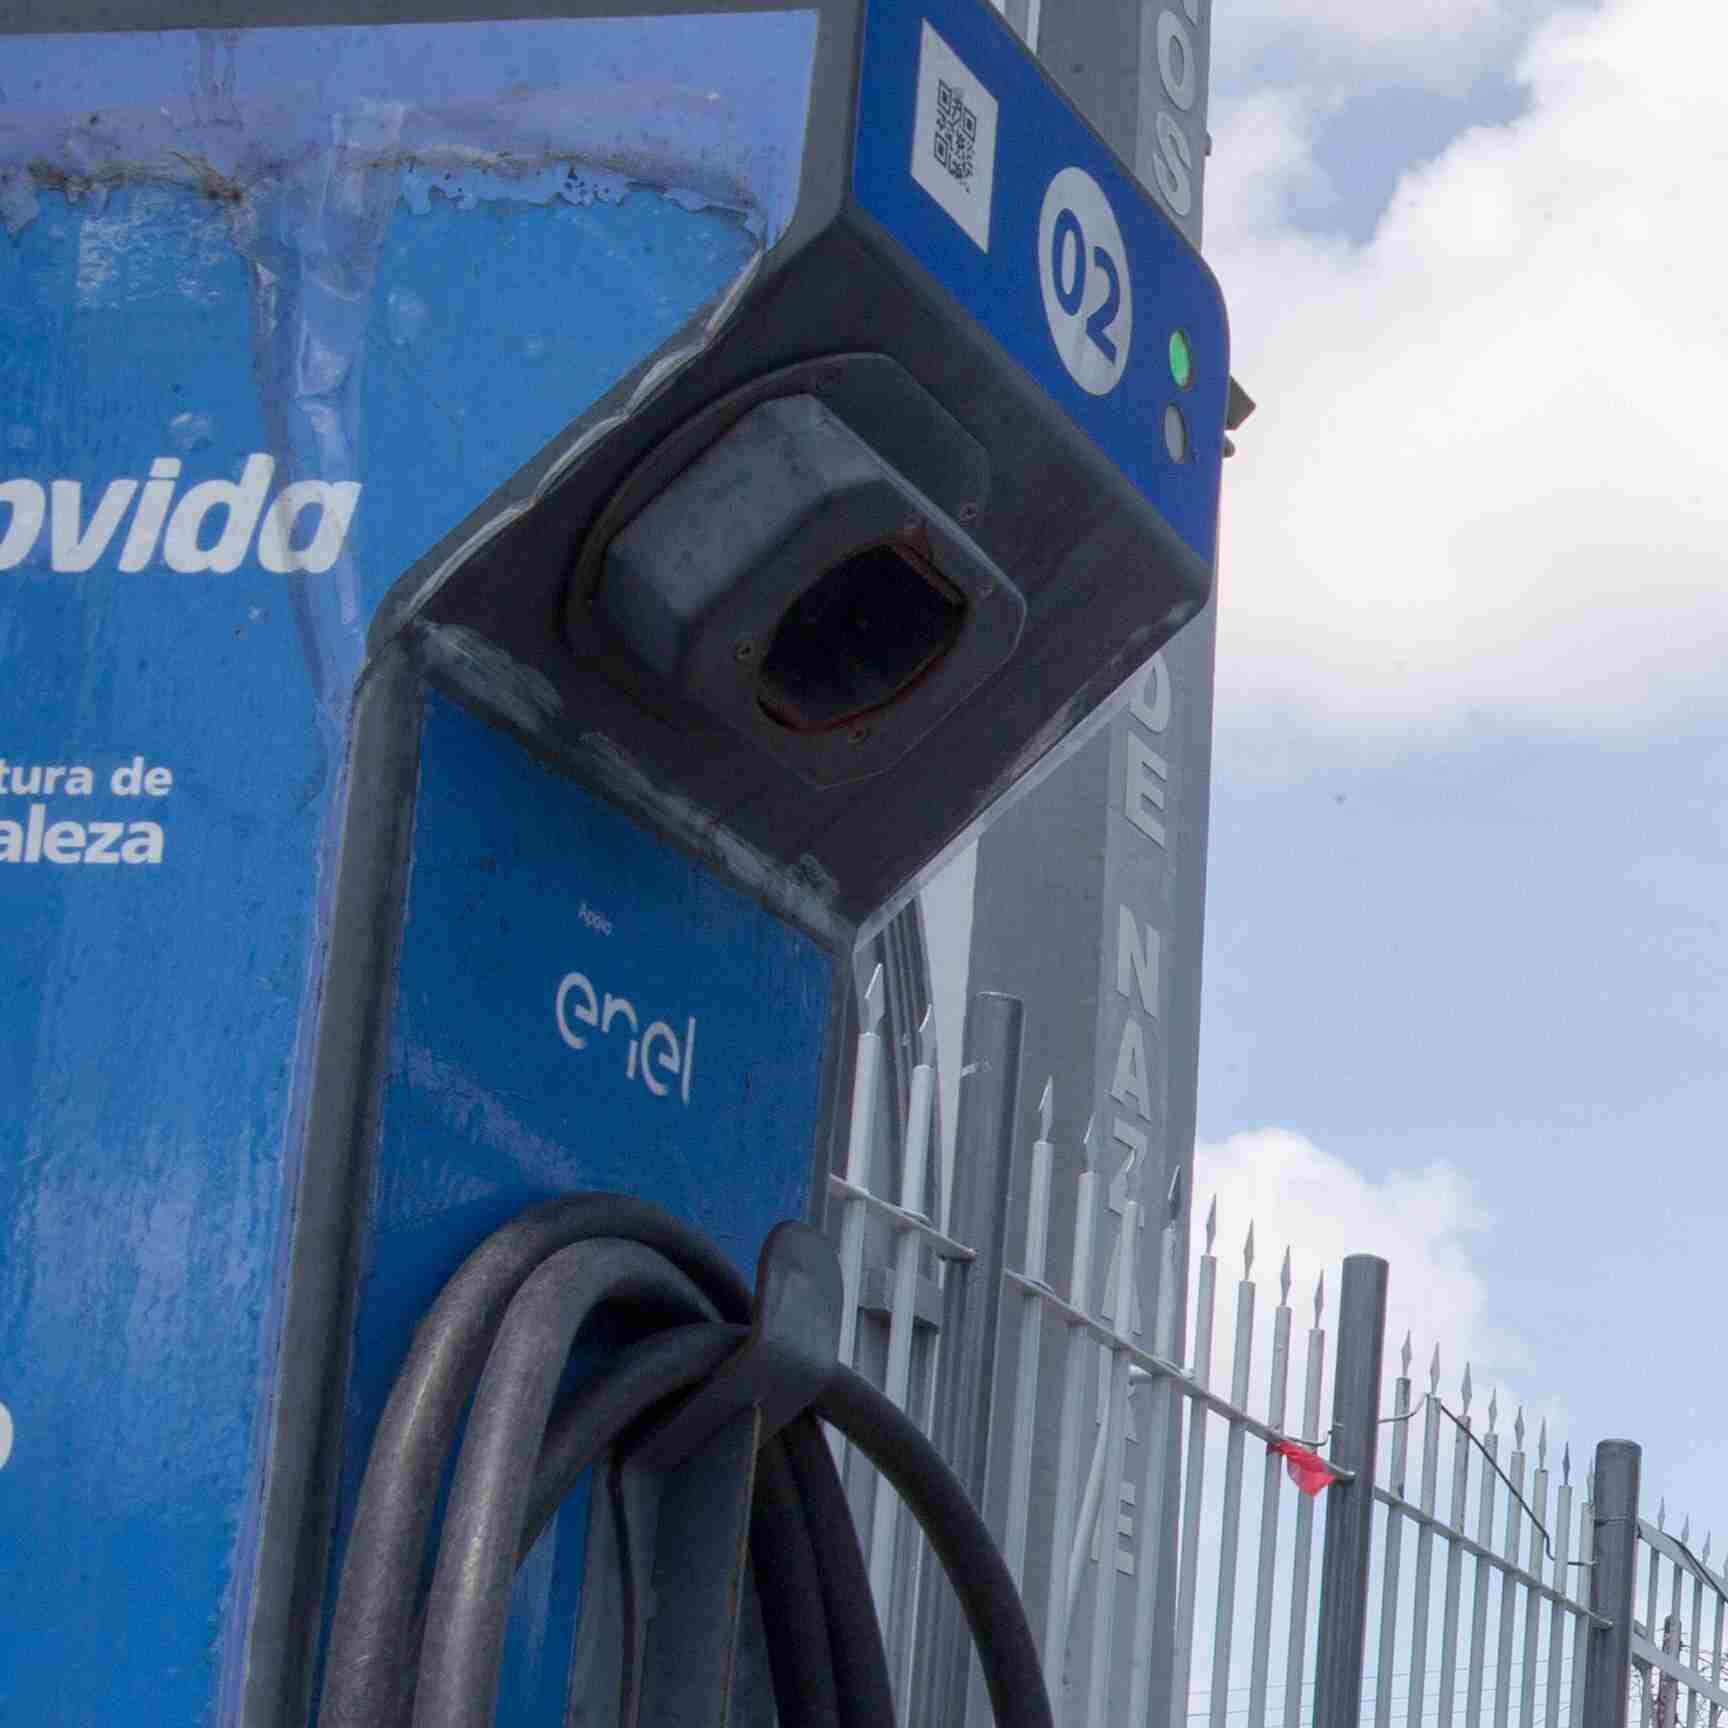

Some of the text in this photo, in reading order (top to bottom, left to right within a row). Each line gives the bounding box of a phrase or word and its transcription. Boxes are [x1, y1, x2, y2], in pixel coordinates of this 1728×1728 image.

[1050, 207, 1122, 365] 02
[111, 756, 173, 797] de
[556, 971, 697, 1105] enel
